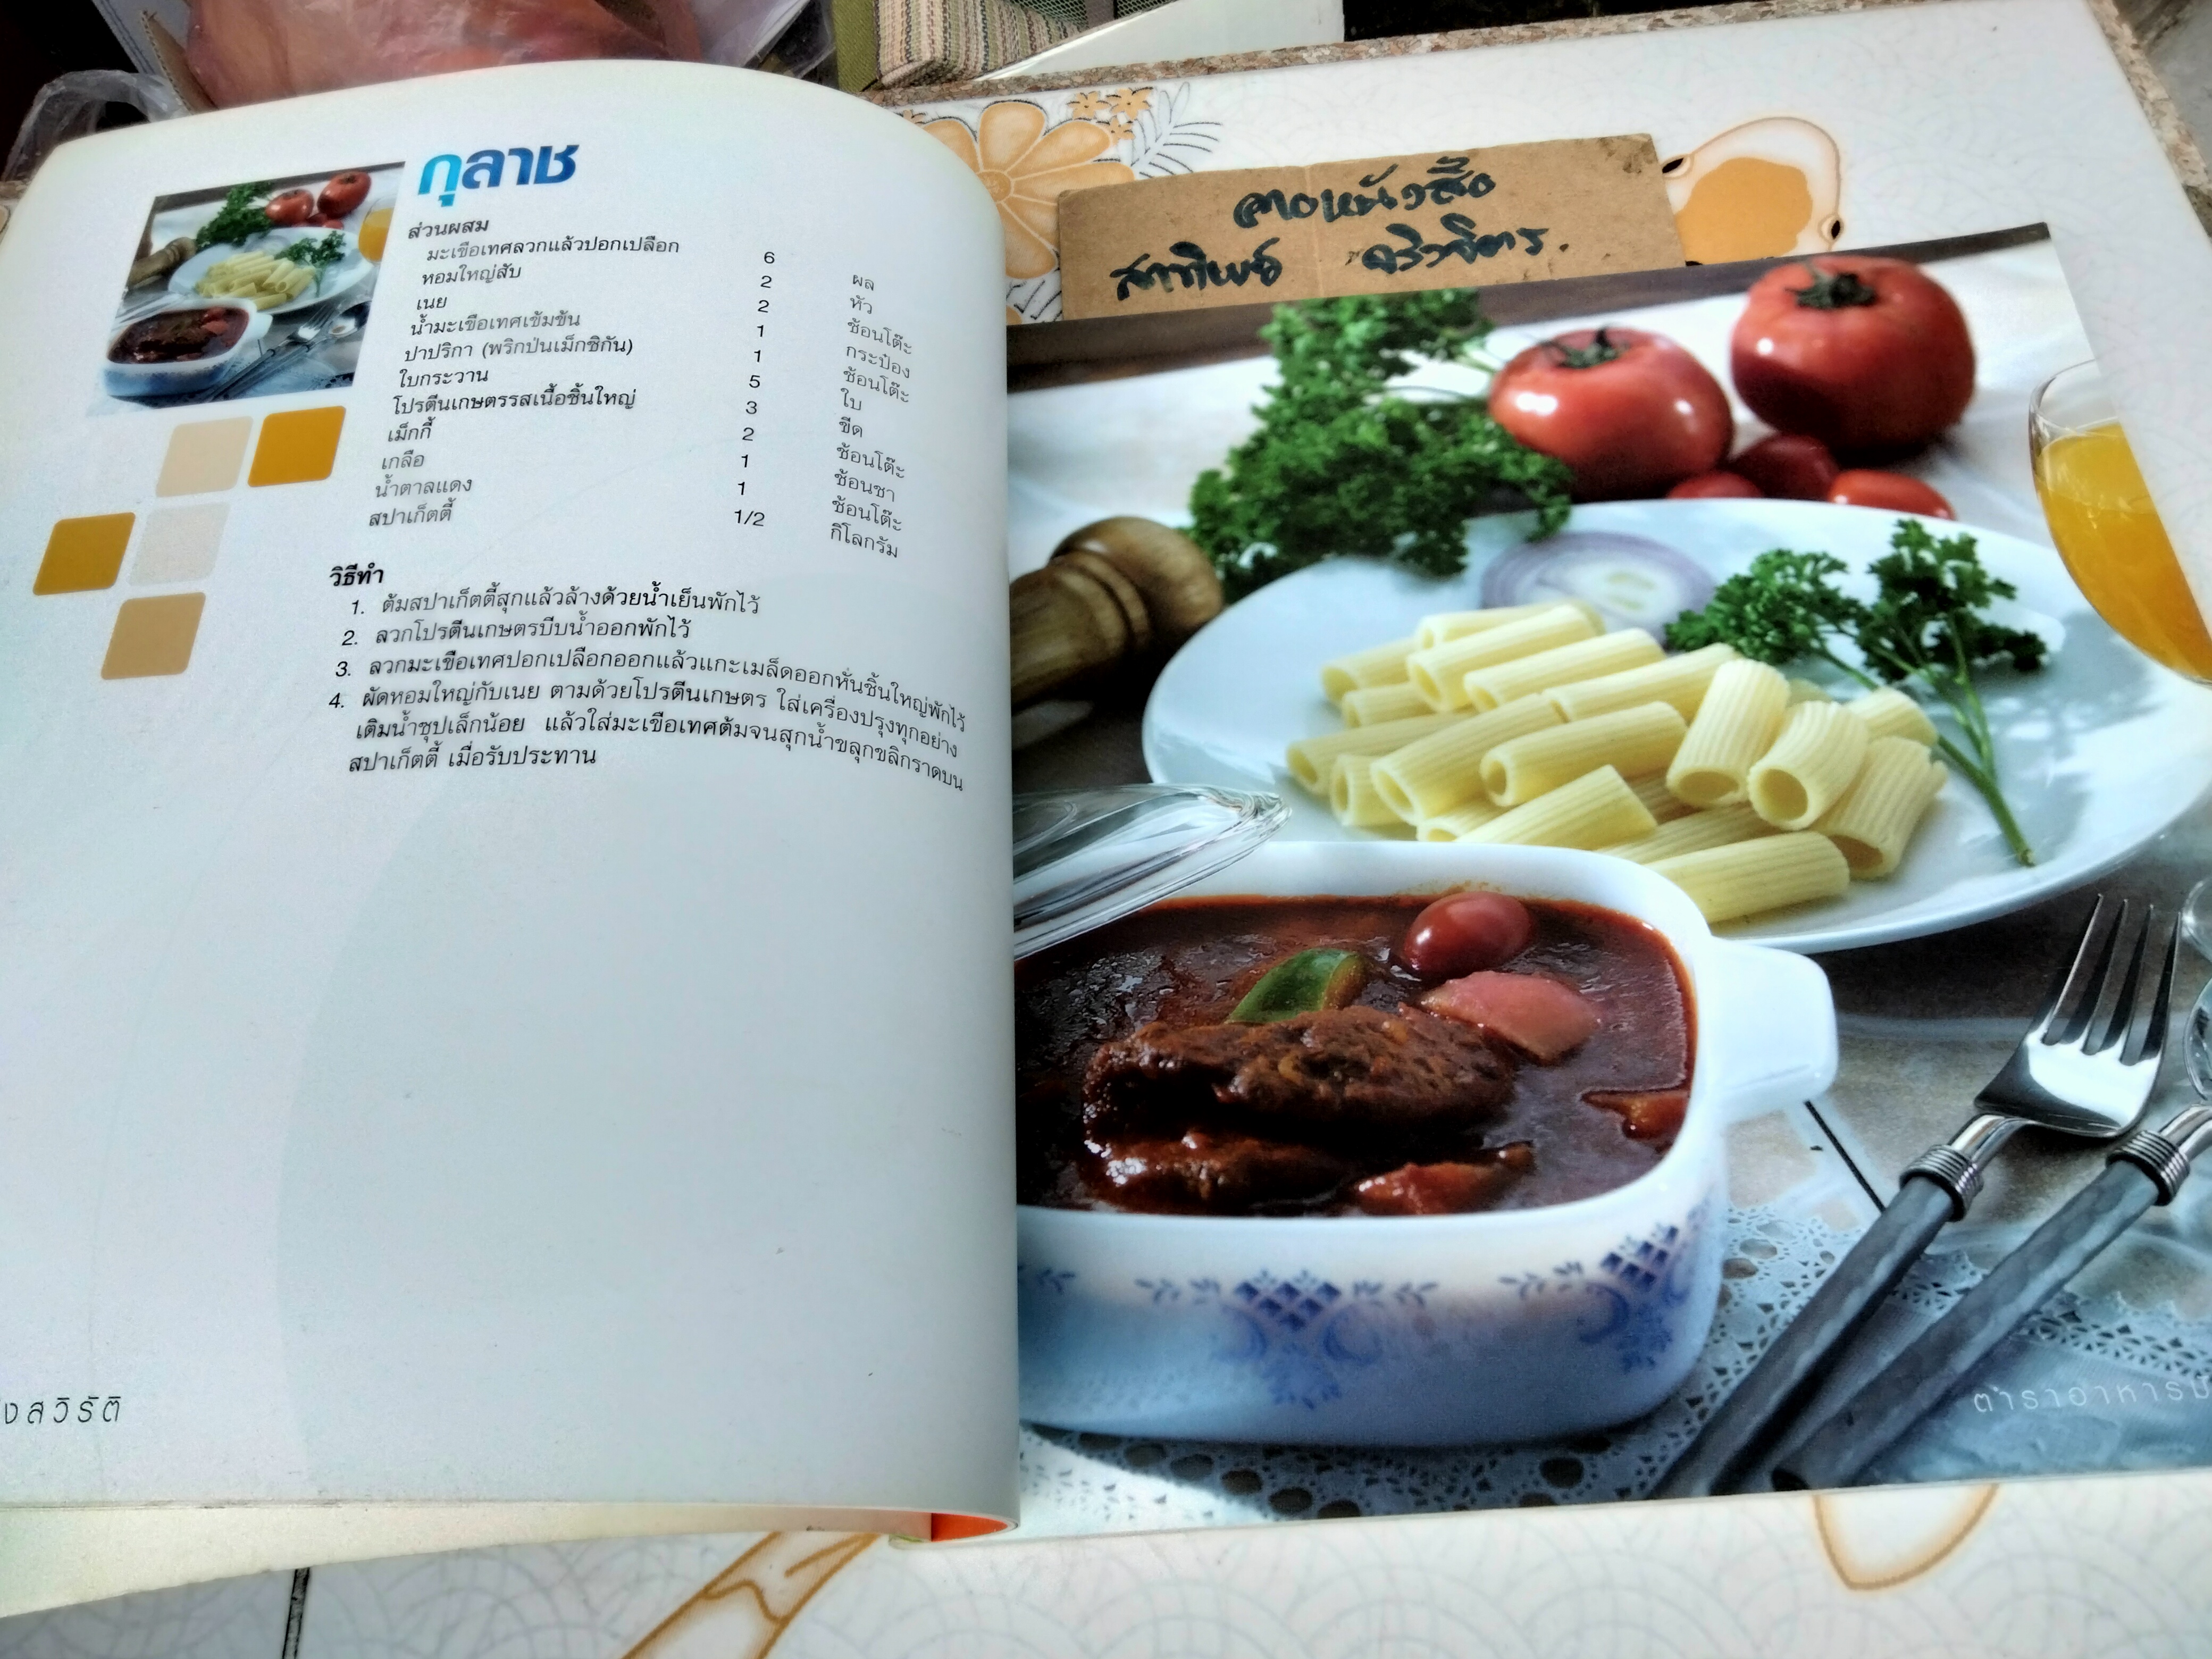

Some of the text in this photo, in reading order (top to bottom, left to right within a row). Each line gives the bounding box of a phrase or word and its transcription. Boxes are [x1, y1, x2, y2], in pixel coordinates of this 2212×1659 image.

[418, 144, 580, 207] กุลาช
[408, 219, 489, 239] ส่วนผสม
[422, 263, 873, 315] หอมใหญ่สับ 2 หัว
[426, 236, 875, 291] มะเขือเทศลวกแล้วปอกเปลือก 6 ผล
[410, 311, 910, 379] น้ำมะเขือเทศเข้มข้น 1 กระป๋อง
[416, 296, 912, 355] เนย 2 ช้อนโต๊ะ
[399, 367, 862, 412] ใบกระวาน 5 ใบ
[405, 341, 473, 363] ปาปริกา
[753, 350, 761, 363] 1
[843, 366, 909, 404] ช้อนโต๊ะ
[392, 383, 863, 439] โปรตีนเกษตรรสเนื้อชิ้นใหญ่ 3 ขีด
[387, 416, 905, 479] เม็กกี้ 2 ช้อนโต๊ะ
[381, 449, 895, 502] เกลือ 1 ช้อนชา
[368, 497, 898, 558] สปาเก็ตตี้ 1/2 กิโลกรัม
[375, 474, 902, 532] น้ำตาลแดง 1 ช้อนโต๊ะ
[329, 563, 384, 586] วิธีทำ
[350, 600, 365, 615] 1.
[341, 631, 359, 646] 2.
[329, 693, 345, 709] 4.
[363, 680, 541, 707] ผัดหอมใหญ่กับเนย
[550, 676, 767, 708] ตามด้วยโปรตีนเกษตร
[335, 661, 351, 677] 3.
[348, 741, 597, 773] สปาเก็ตตี้ เมื่อรับประทาน
